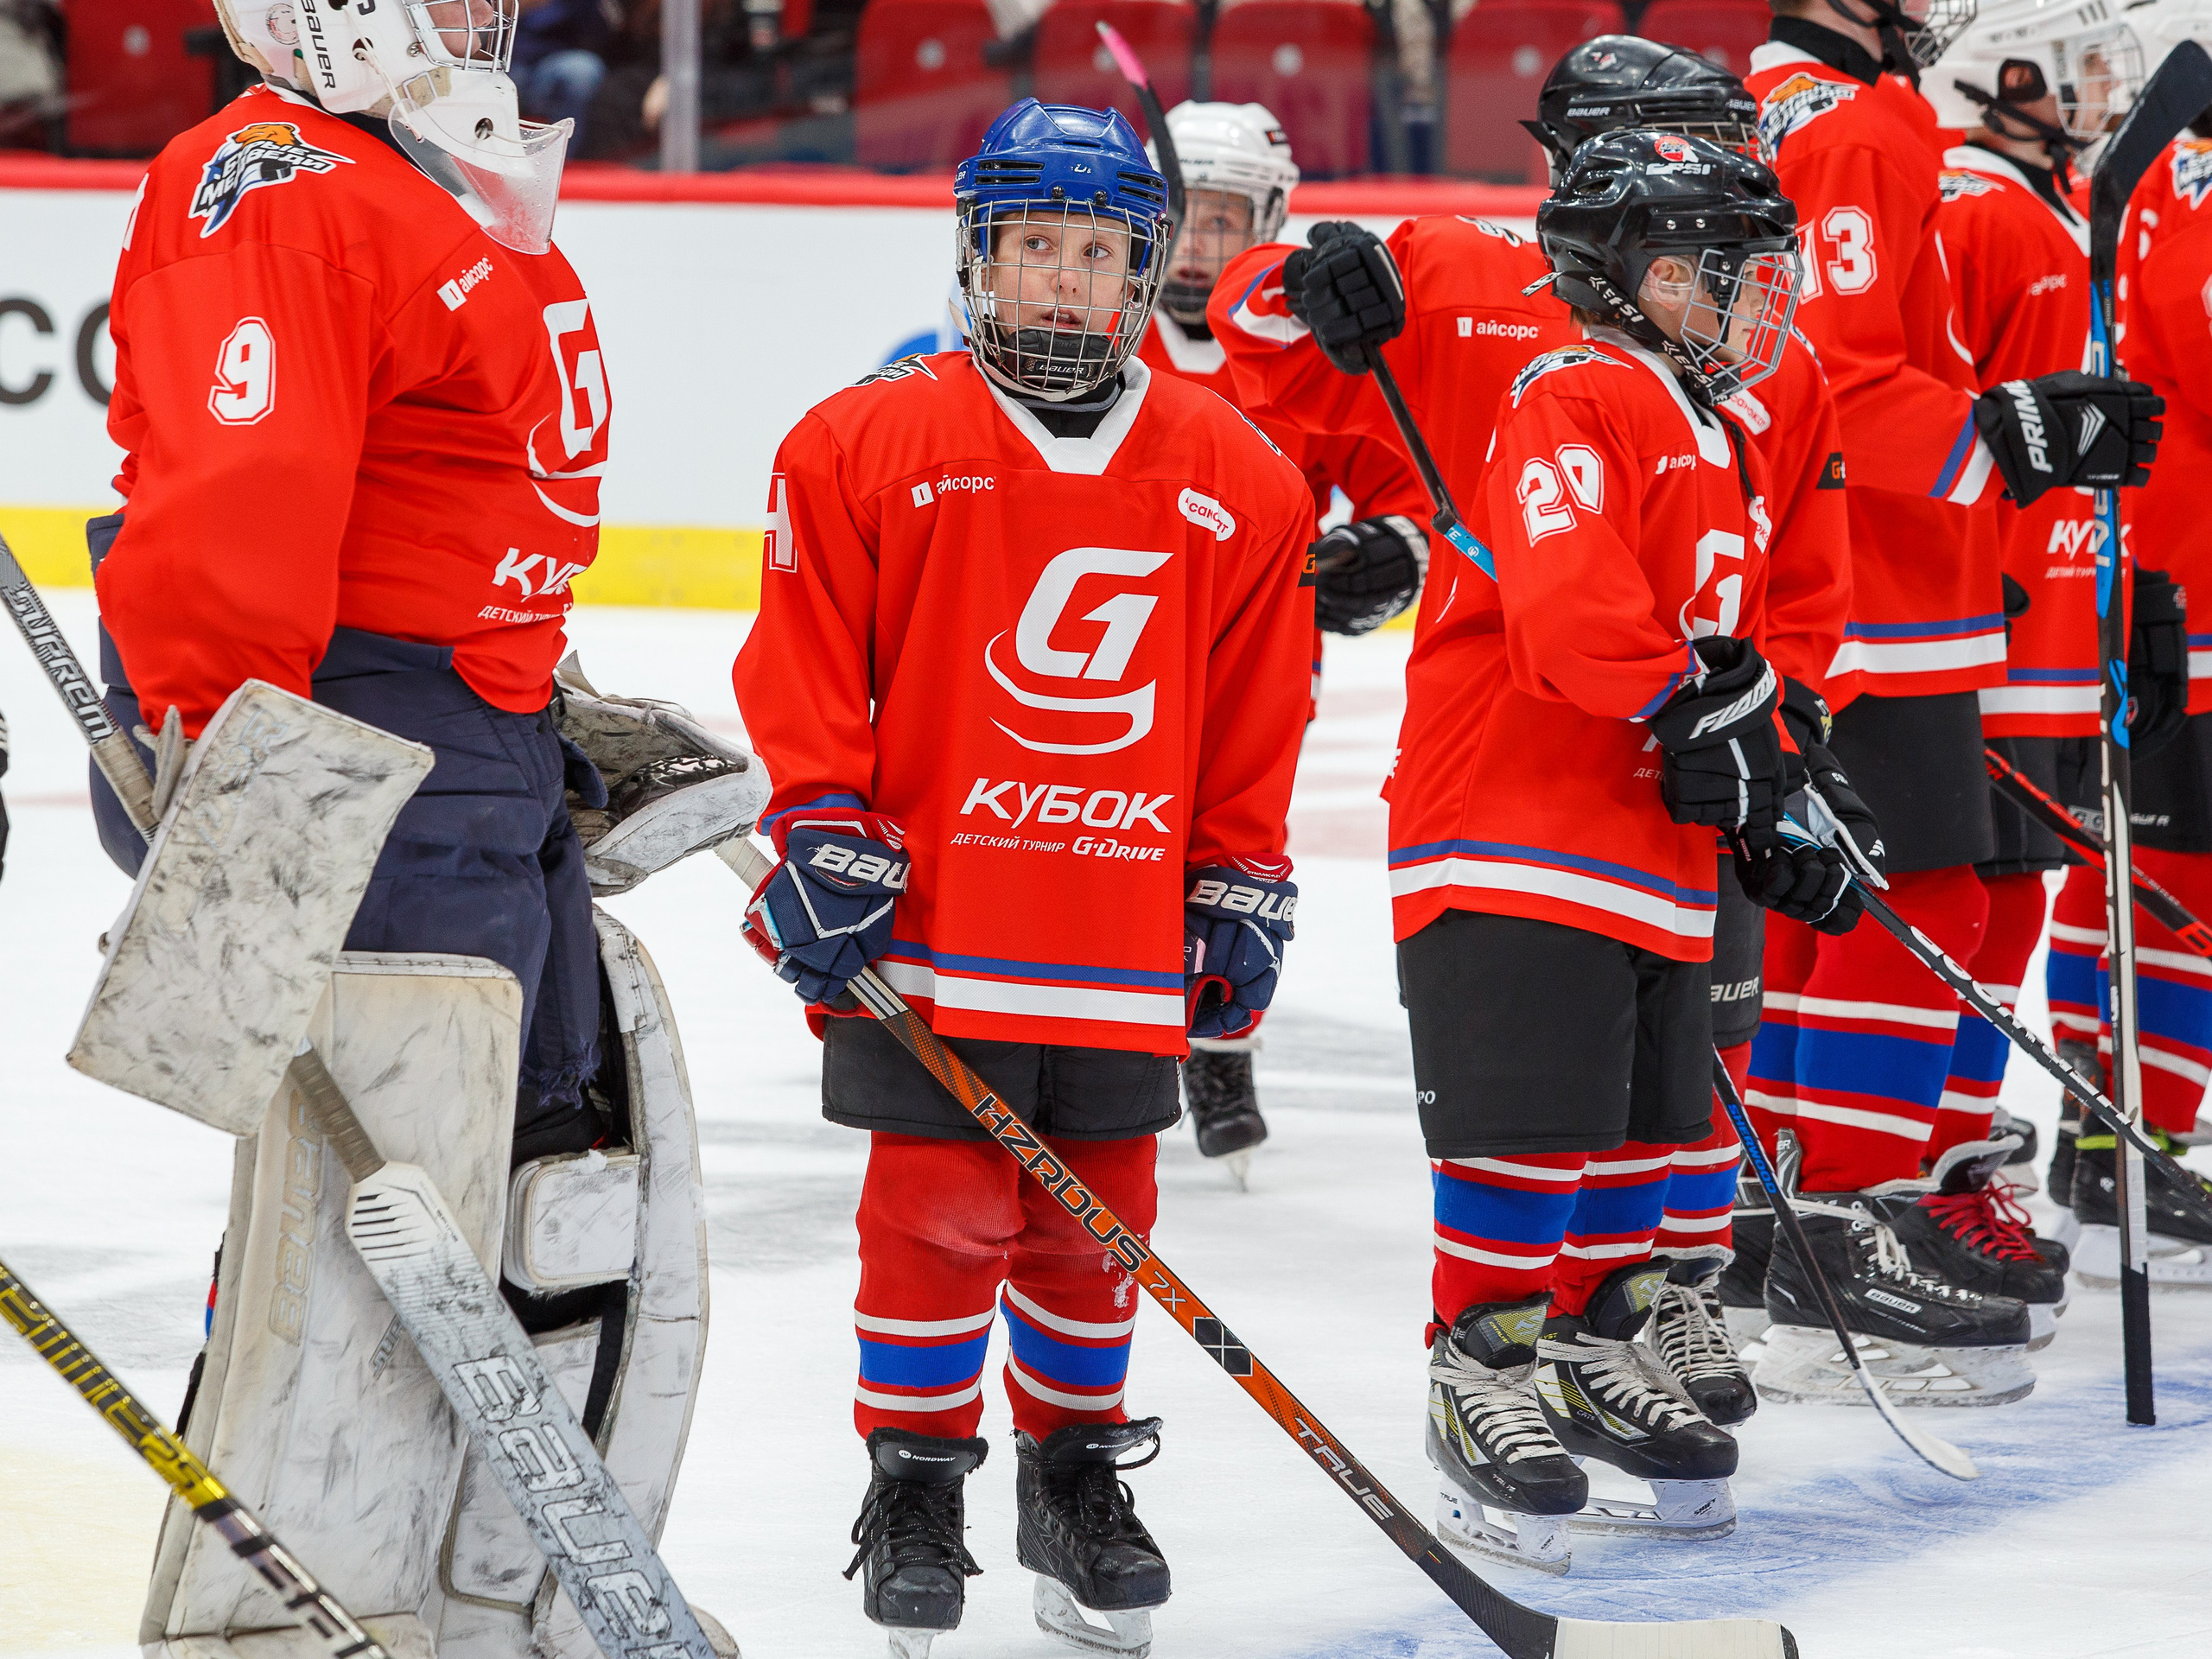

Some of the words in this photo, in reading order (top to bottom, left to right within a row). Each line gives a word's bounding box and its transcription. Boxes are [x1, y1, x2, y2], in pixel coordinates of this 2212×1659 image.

[1476, 320, 1539, 340] айсорс
[207, 317, 276, 425] 9
[1516, 443, 1605, 548] 20
[959, 778, 1175, 833] КУБОК
[950, 832, 1021, 850] ДЕТСКИЙ
[1021, 839, 1066, 853] ТУРНИР
[1727, 1103, 1777, 1195] SHERWOOD
[972, 1092, 1149, 1272] HZRDUS
[1147, 1270, 1186, 1313] 7X
[1489, 1321, 1510, 1344] CATALYST
[1294, 1417, 1395, 1522] TRUE
[1440, 1491, 1459, 1504] TRUE
